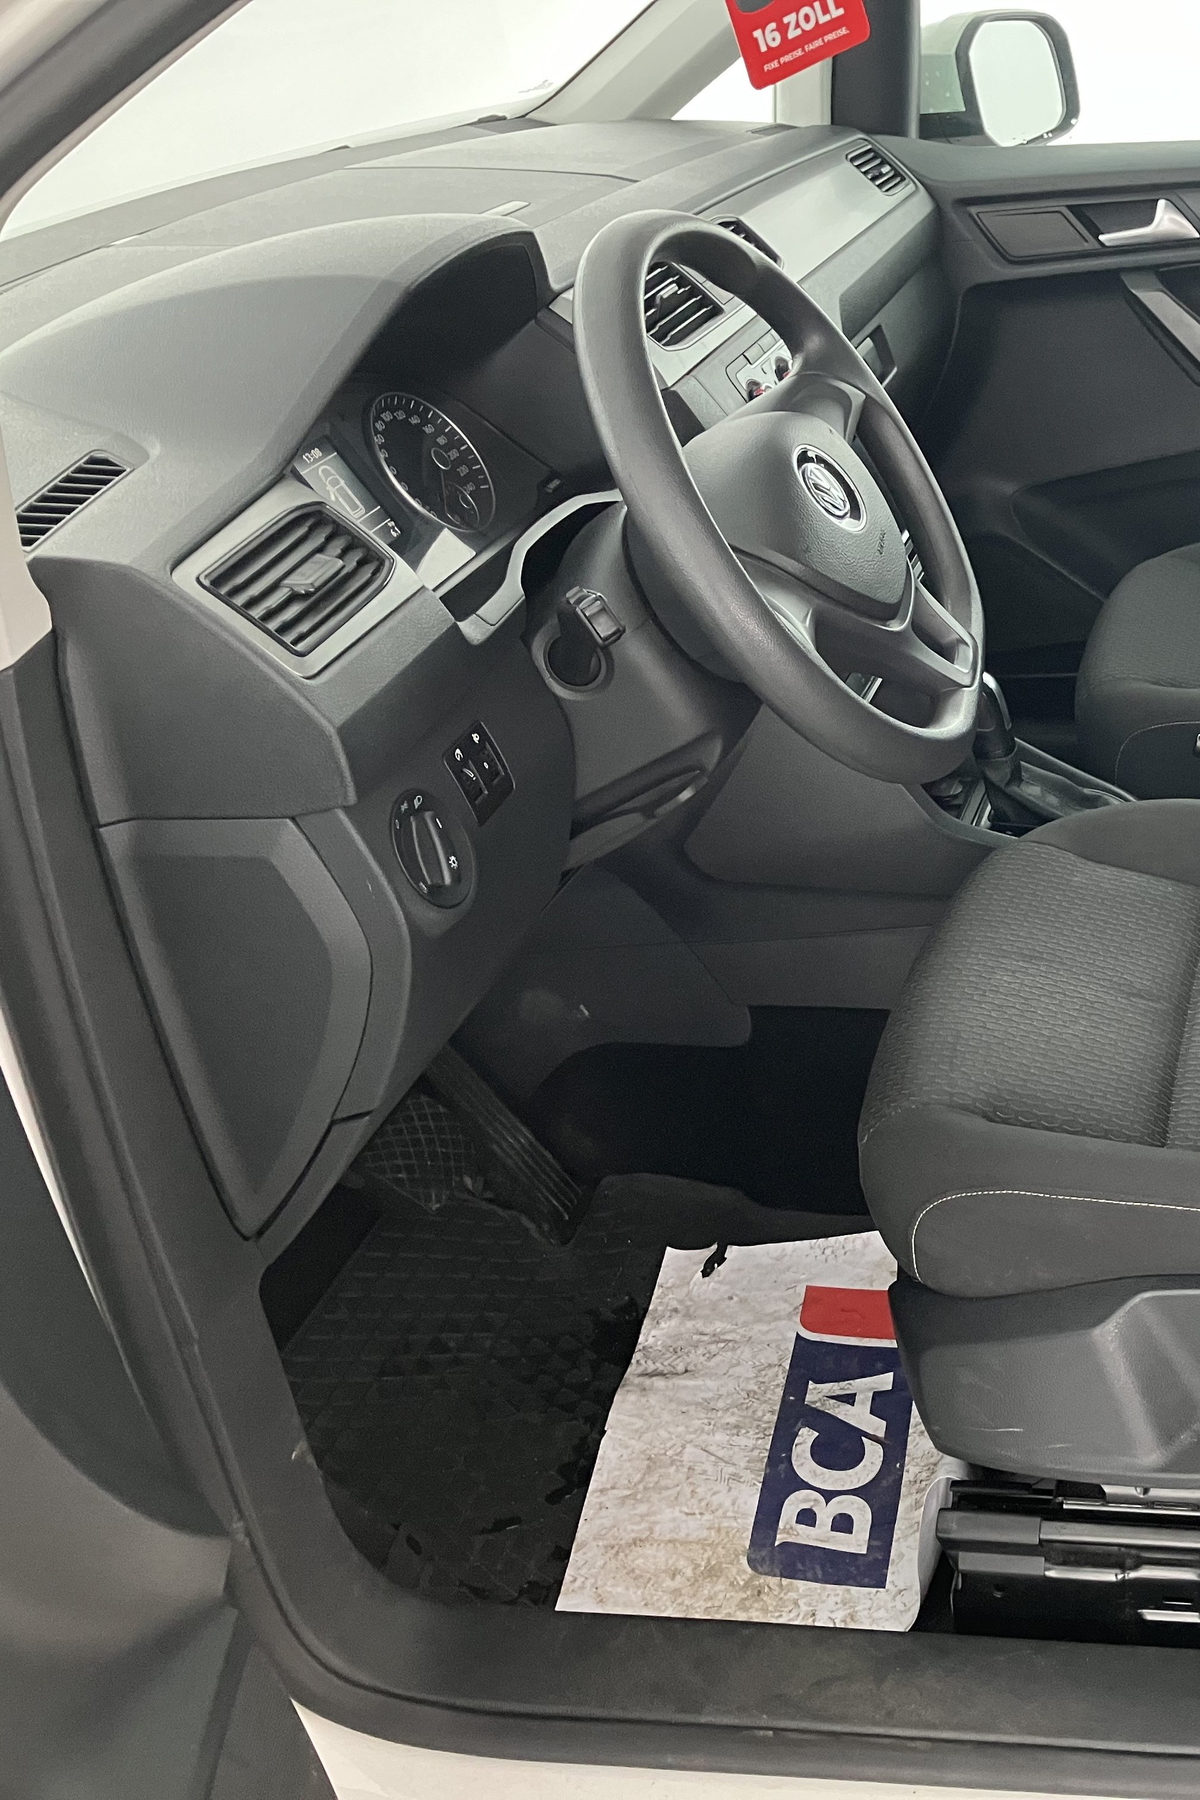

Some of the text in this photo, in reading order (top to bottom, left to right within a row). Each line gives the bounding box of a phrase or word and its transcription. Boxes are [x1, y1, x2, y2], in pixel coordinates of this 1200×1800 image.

[752, 0, 845, 53] 16 ZOLL
[763, 60, 780, 72] FIXE
[804, 37, 825, 53] FAIRE
[302, 447, 323, 463] 13:08
[774, 1371, 894, 1556] BCA
